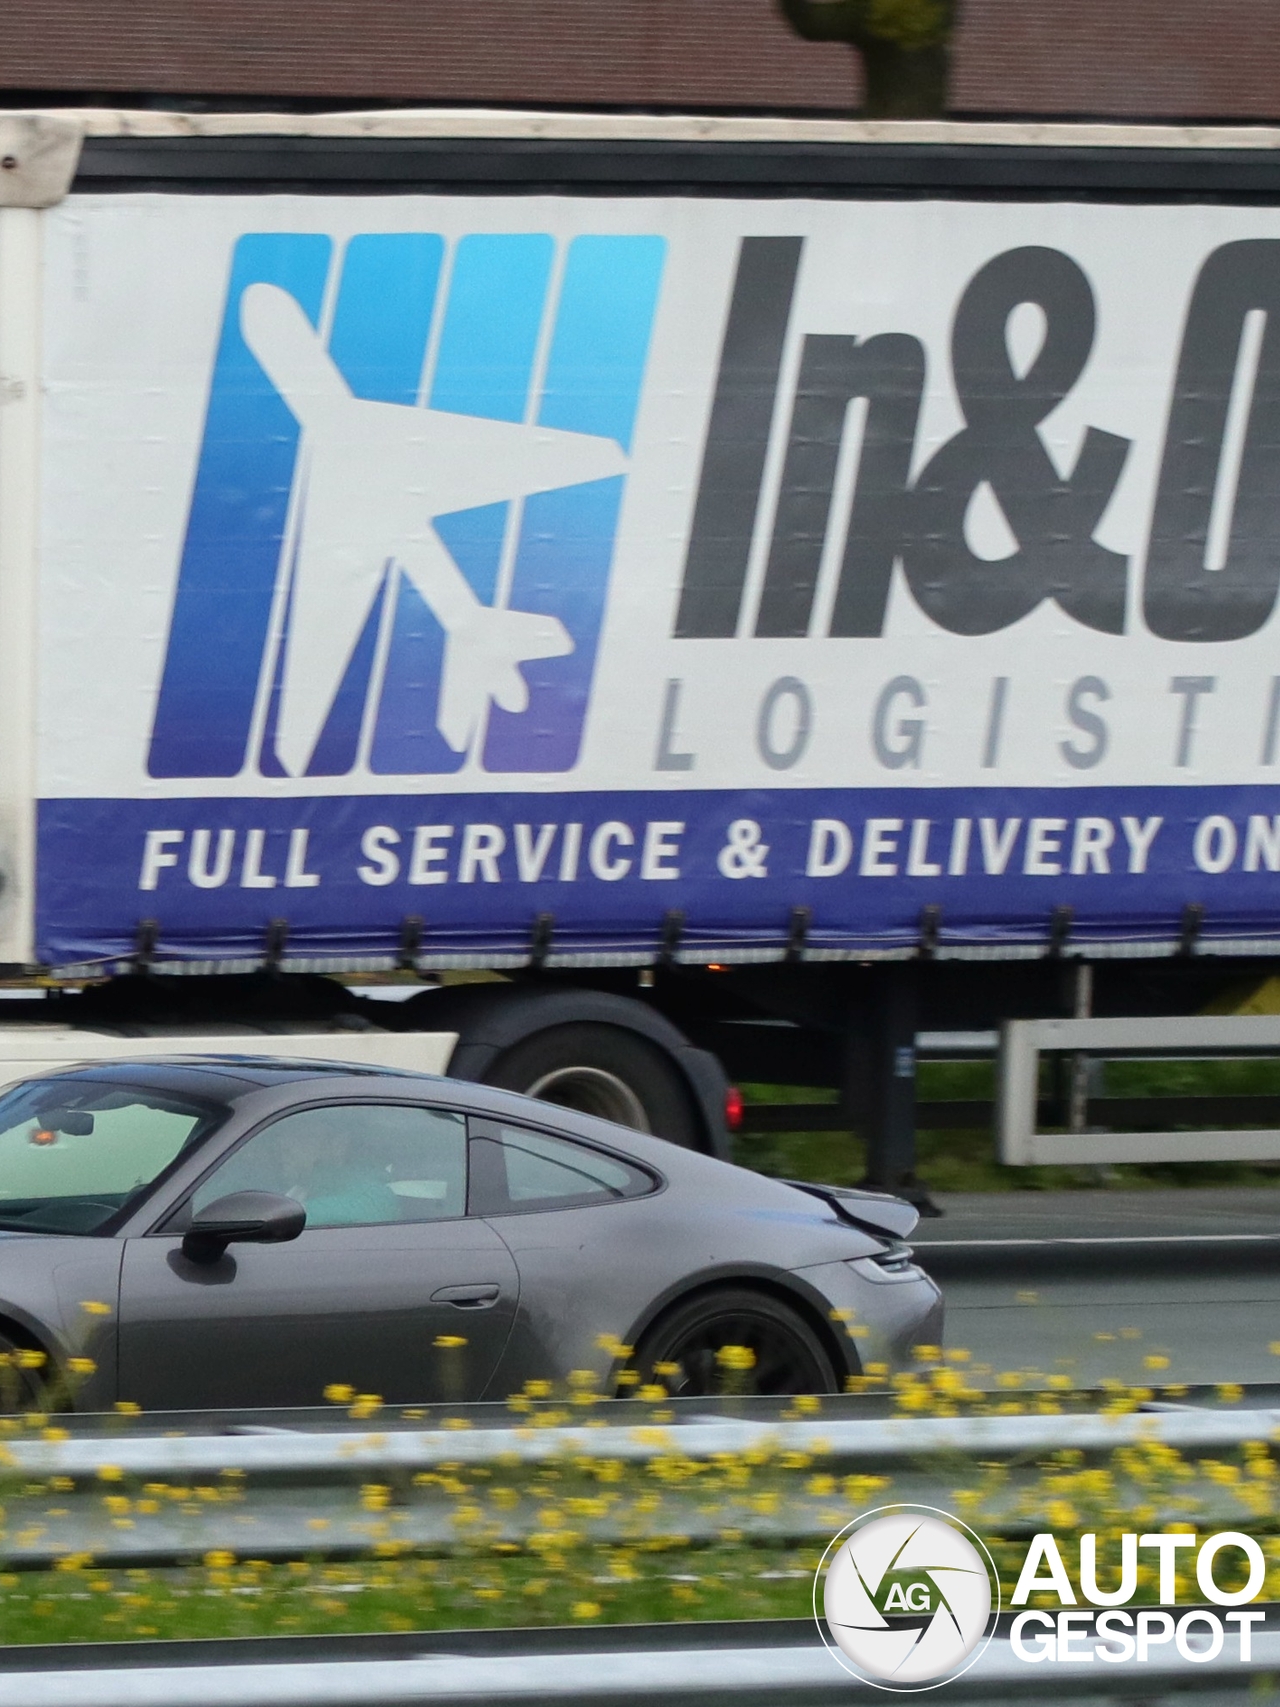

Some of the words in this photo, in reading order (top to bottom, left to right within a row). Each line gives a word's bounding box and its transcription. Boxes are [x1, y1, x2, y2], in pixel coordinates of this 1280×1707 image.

[138, 829, 320, 891] FULL
[357, 821, 686, 886] SERVICE
[717, 819, 770, 879] &
[806, 815, 1163, 878] DELIVERY
